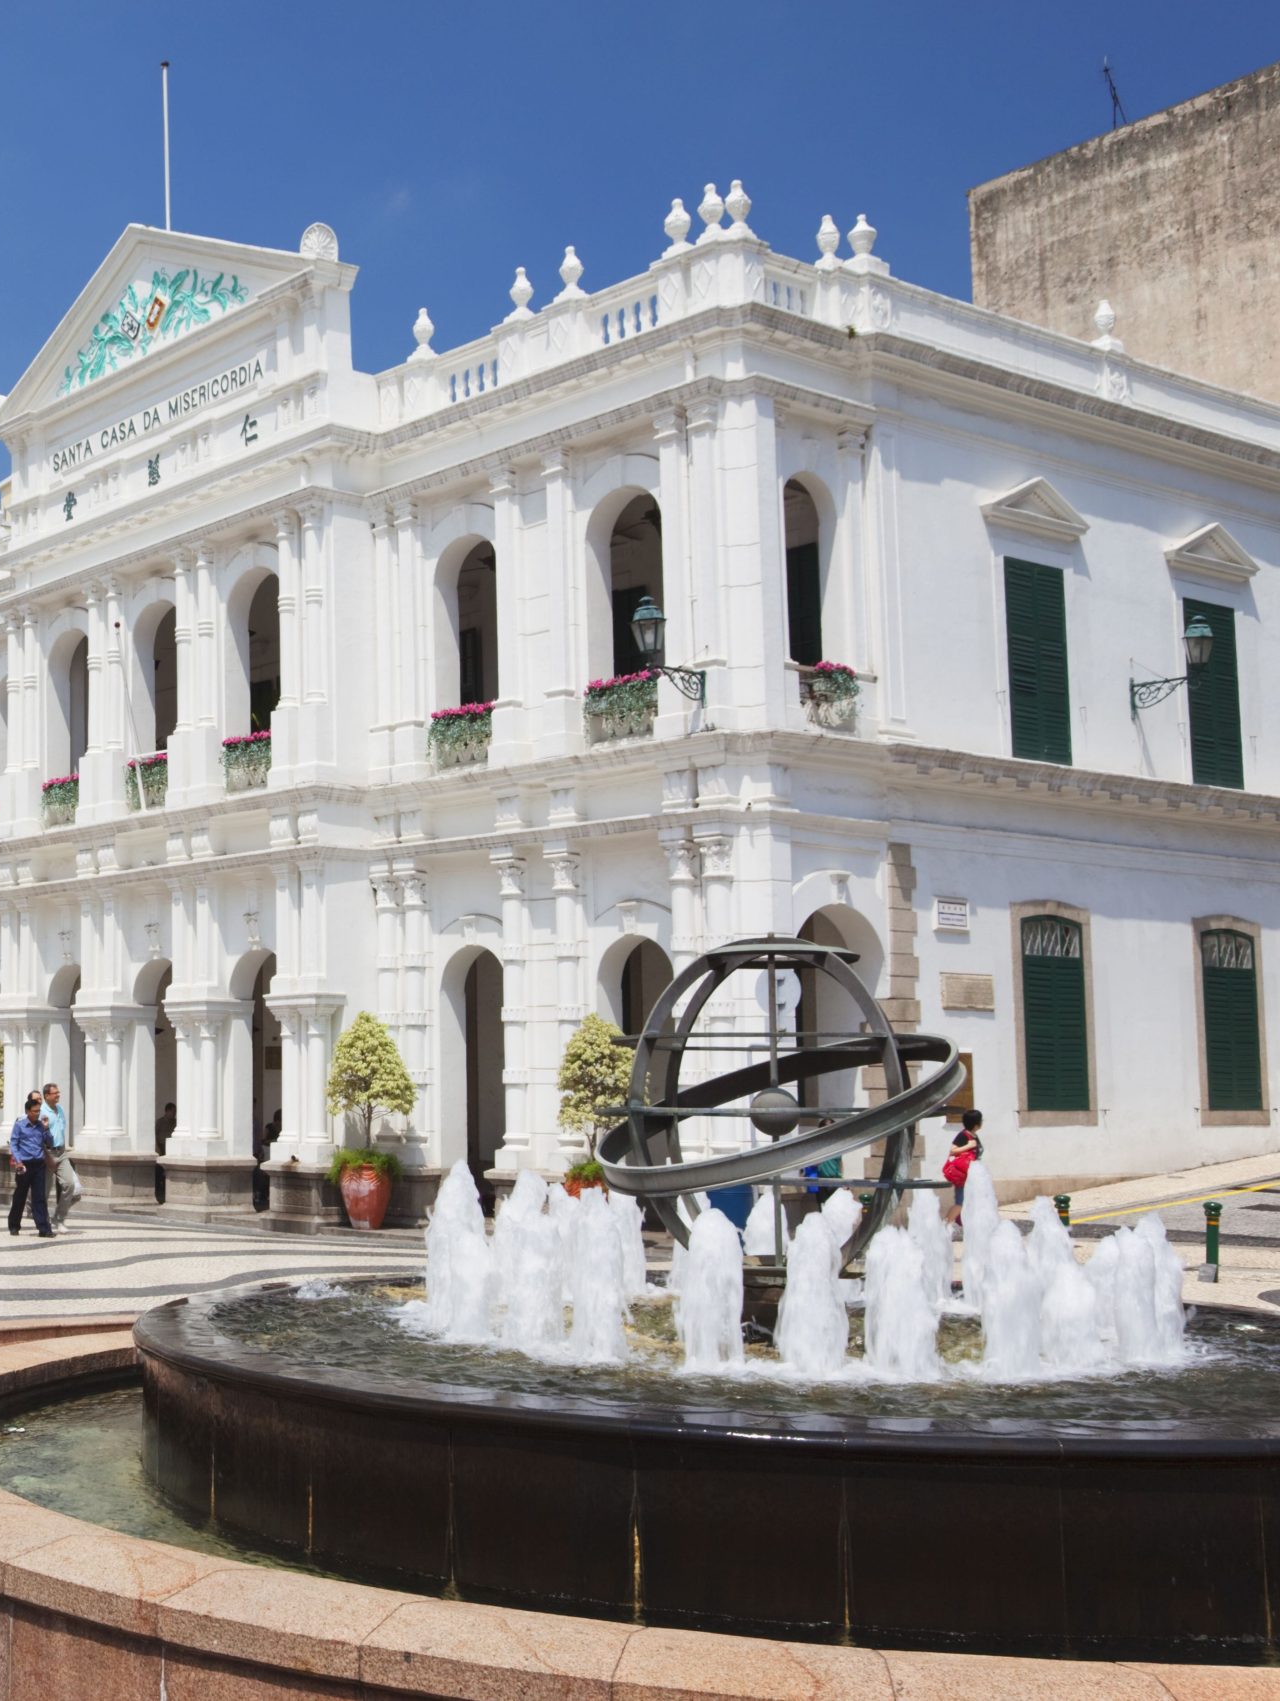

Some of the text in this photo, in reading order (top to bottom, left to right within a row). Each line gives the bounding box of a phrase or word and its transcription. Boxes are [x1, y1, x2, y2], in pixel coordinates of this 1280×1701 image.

[53, 359, 263, 472] SANTA CASA DA MISERICORDIA
